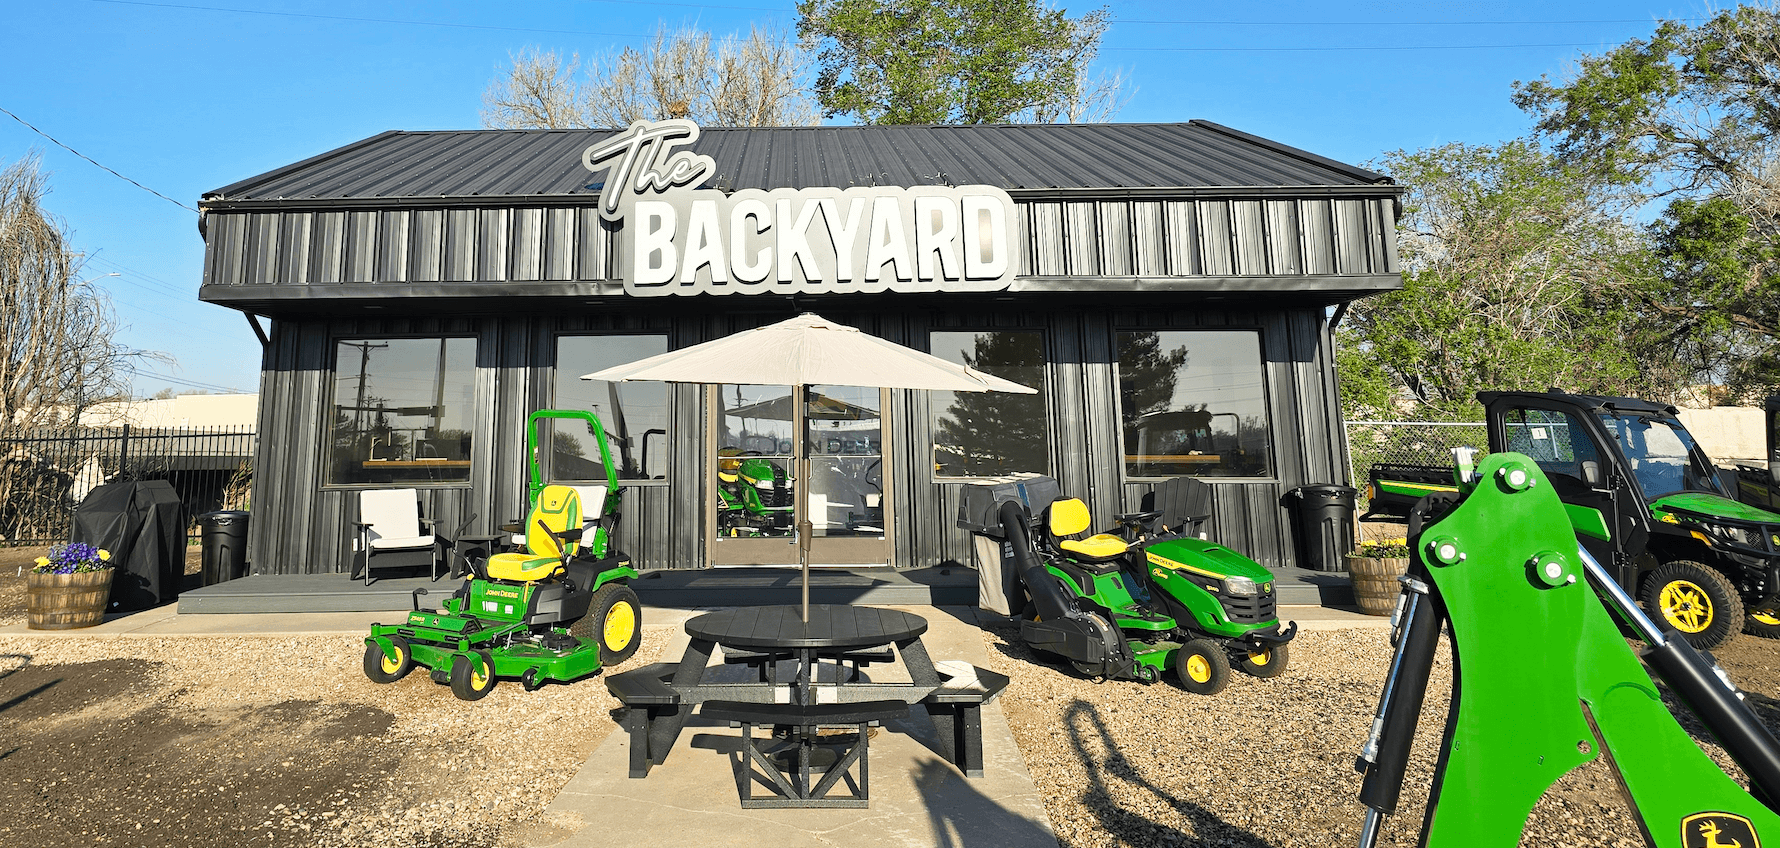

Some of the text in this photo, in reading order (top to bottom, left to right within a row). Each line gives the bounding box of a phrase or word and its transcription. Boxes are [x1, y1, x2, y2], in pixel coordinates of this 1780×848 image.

[590, 125, 707, 212] The
[633, 195, 1009, 286] BACKYARD
[485, 588, 519, 599] JOHN DEERE
